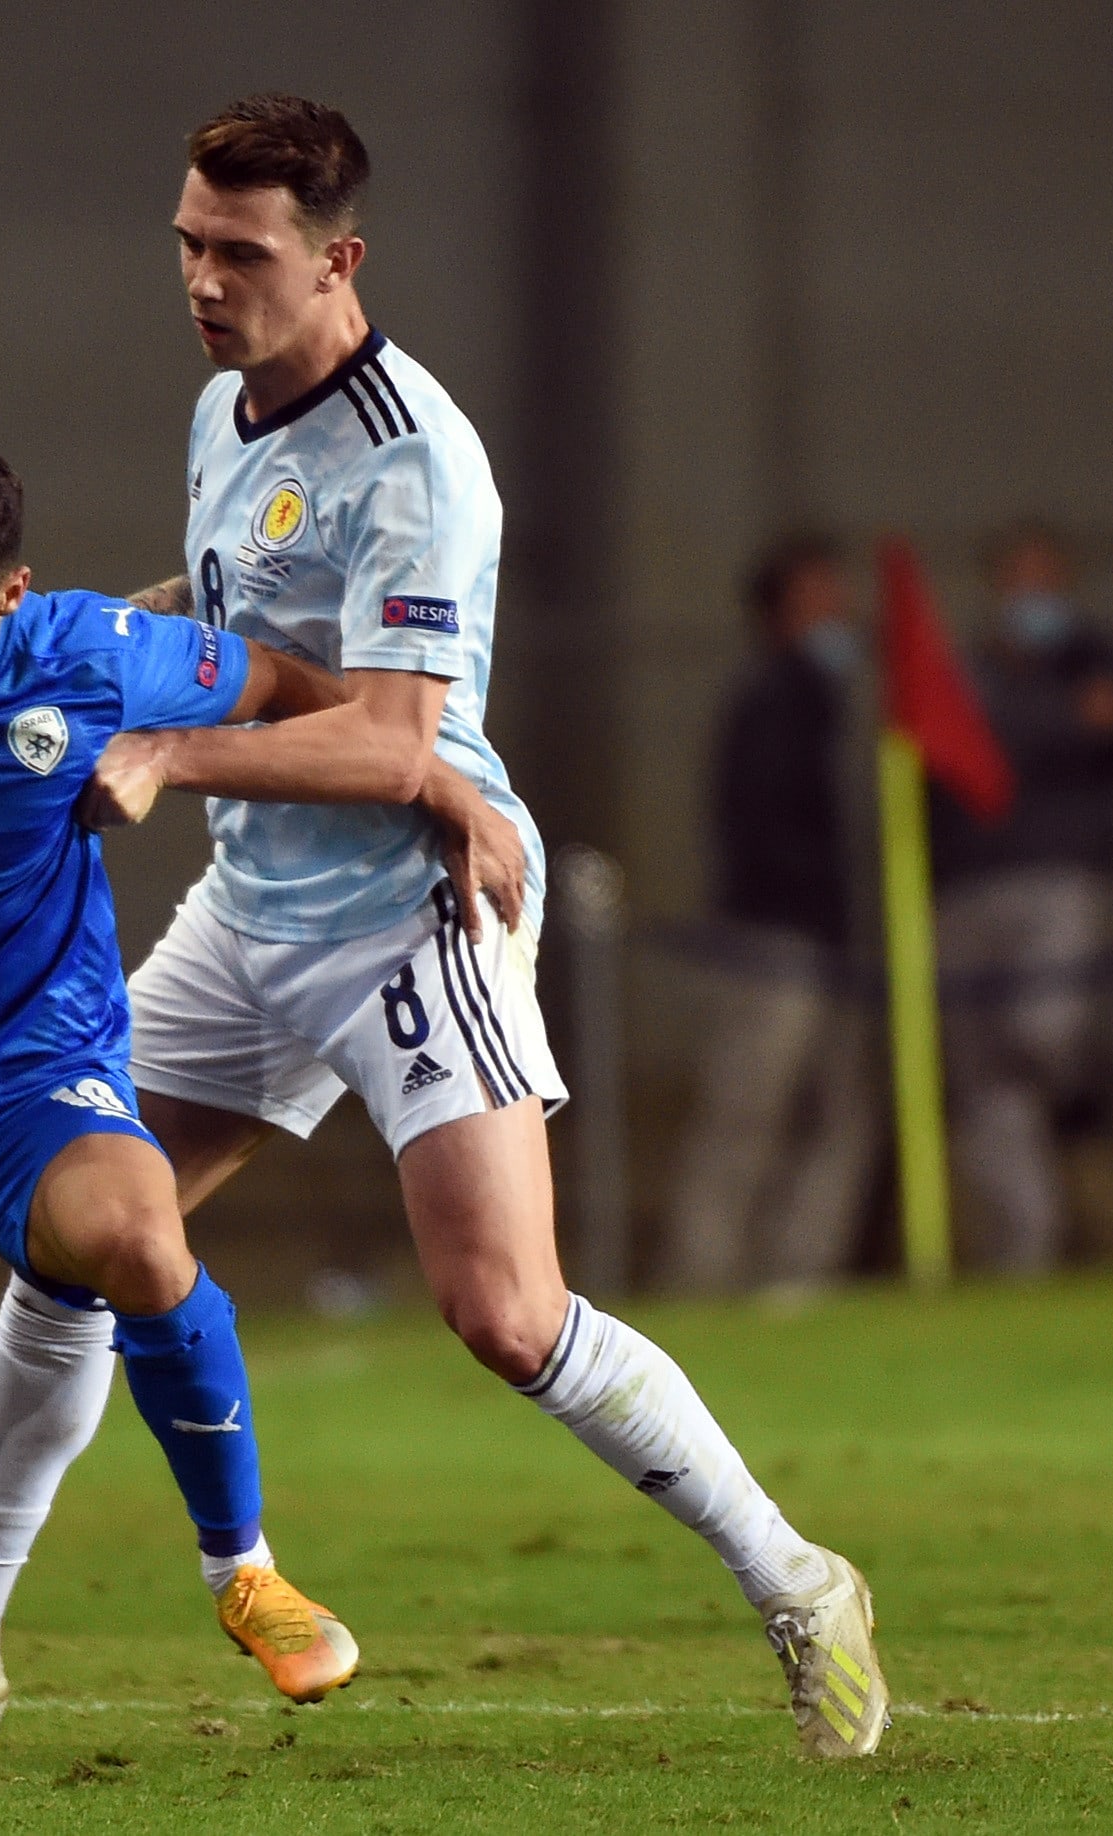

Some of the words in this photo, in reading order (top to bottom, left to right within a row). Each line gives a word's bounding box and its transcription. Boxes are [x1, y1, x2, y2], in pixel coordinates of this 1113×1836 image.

[201, 547, 227, 631] 8
[20, 713, 53, 730] ISRAEL
[380, 962, 430, 1051] 8
[50, 1078, 133, 1109] 10
[401, 1068, 454, 1096] adidas
